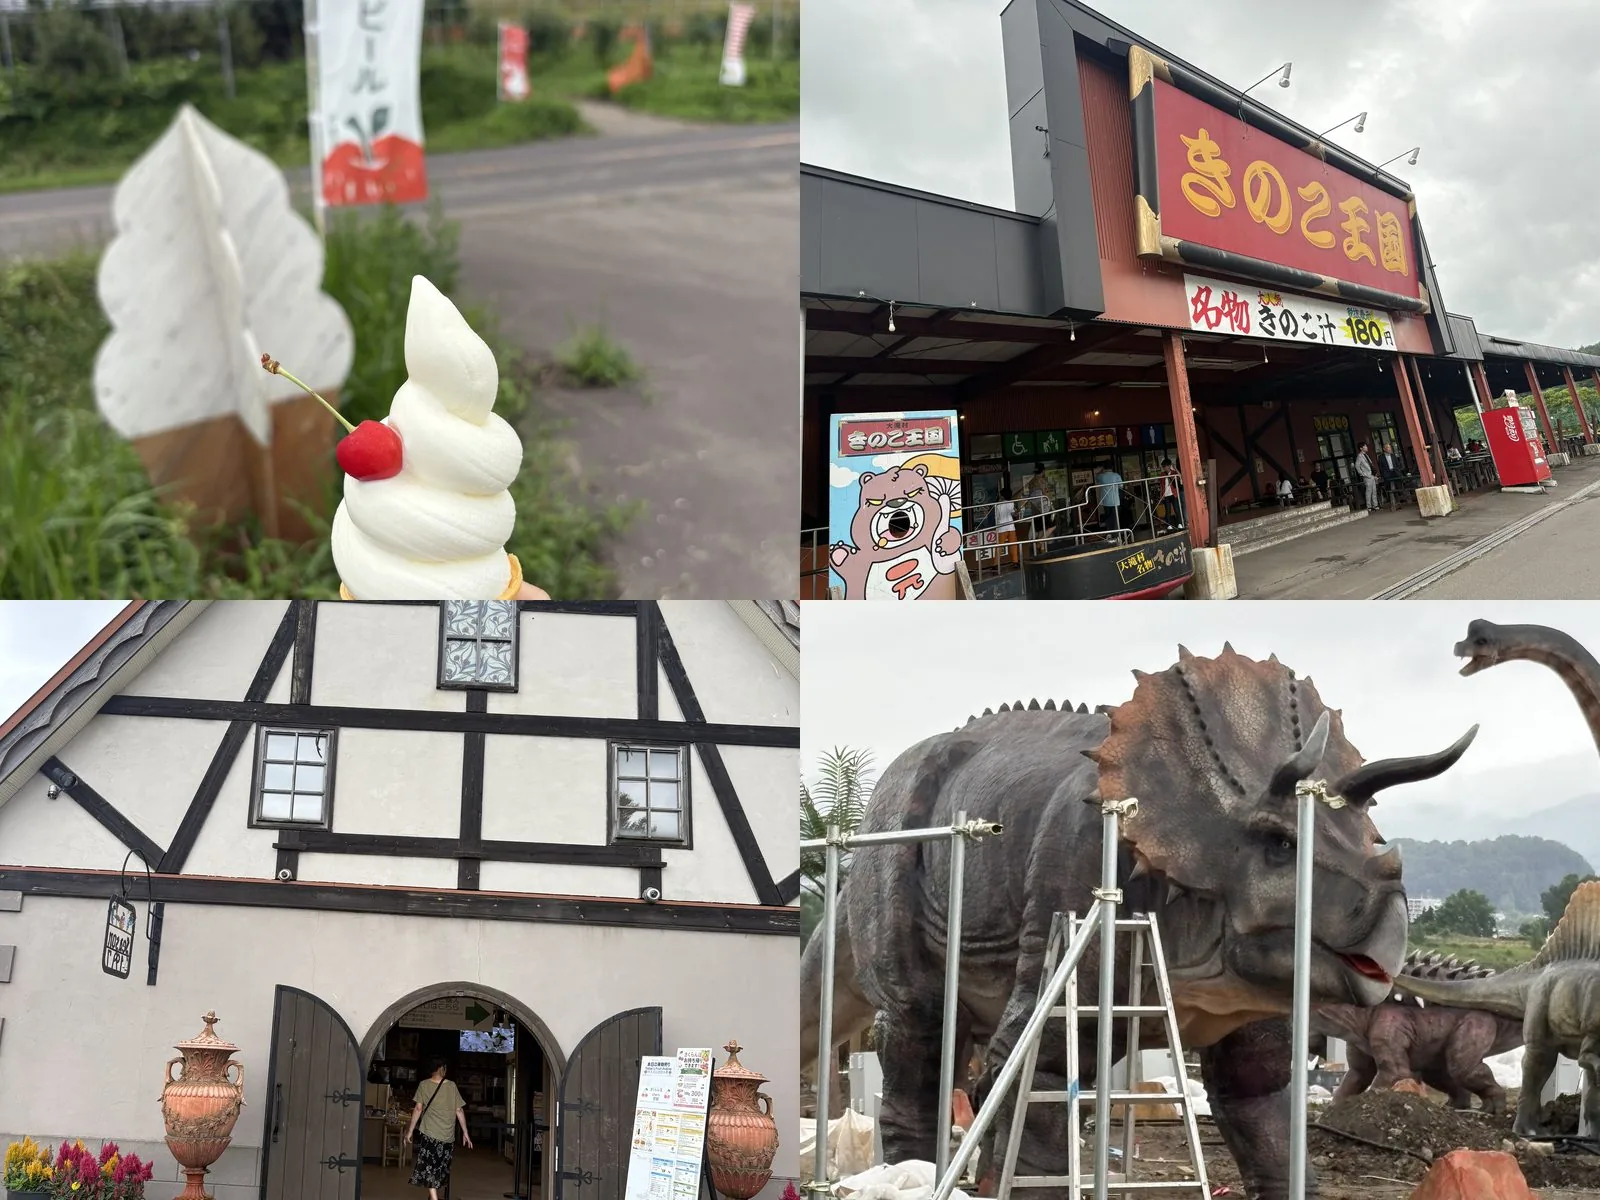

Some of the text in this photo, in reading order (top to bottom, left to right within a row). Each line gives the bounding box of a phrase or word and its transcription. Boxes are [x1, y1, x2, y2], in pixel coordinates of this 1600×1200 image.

[1181, 128, 1409, 276] きのこ王国
[1190, 285, 1251, 335] 名物
[1258, 304, 1337, 344] きのこ汁
[847, 426, 945, 451] きのこ王国
